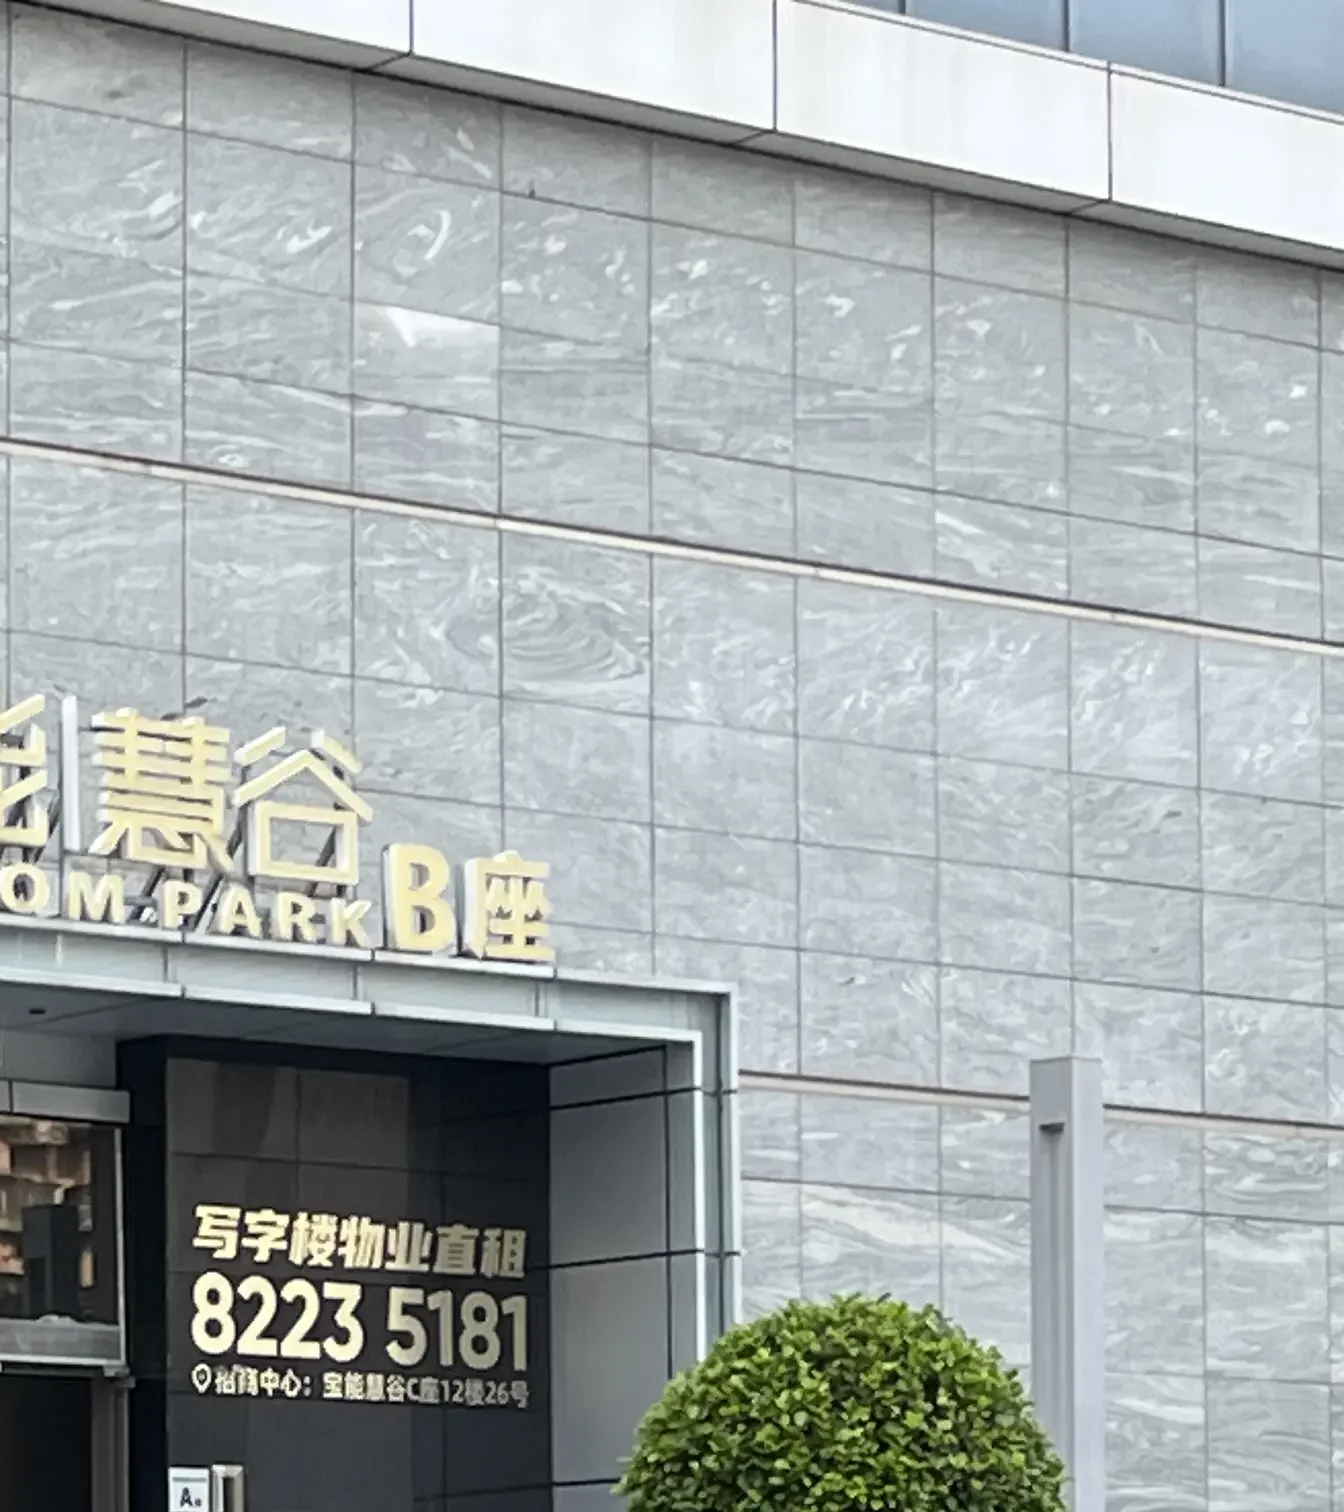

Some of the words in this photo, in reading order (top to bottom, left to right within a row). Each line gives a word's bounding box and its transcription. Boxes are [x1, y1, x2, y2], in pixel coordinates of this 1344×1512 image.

[89, 706, 375, 885] 慧谷
[162, 879, 374, 948] PARK
[384, 842, 558, 961] B座
[192, 1205, 527, 1279] 写字楼物业直租
[190, 1271, 365, 1363] 8223
[385, 1286, 528, 1372] 5181
